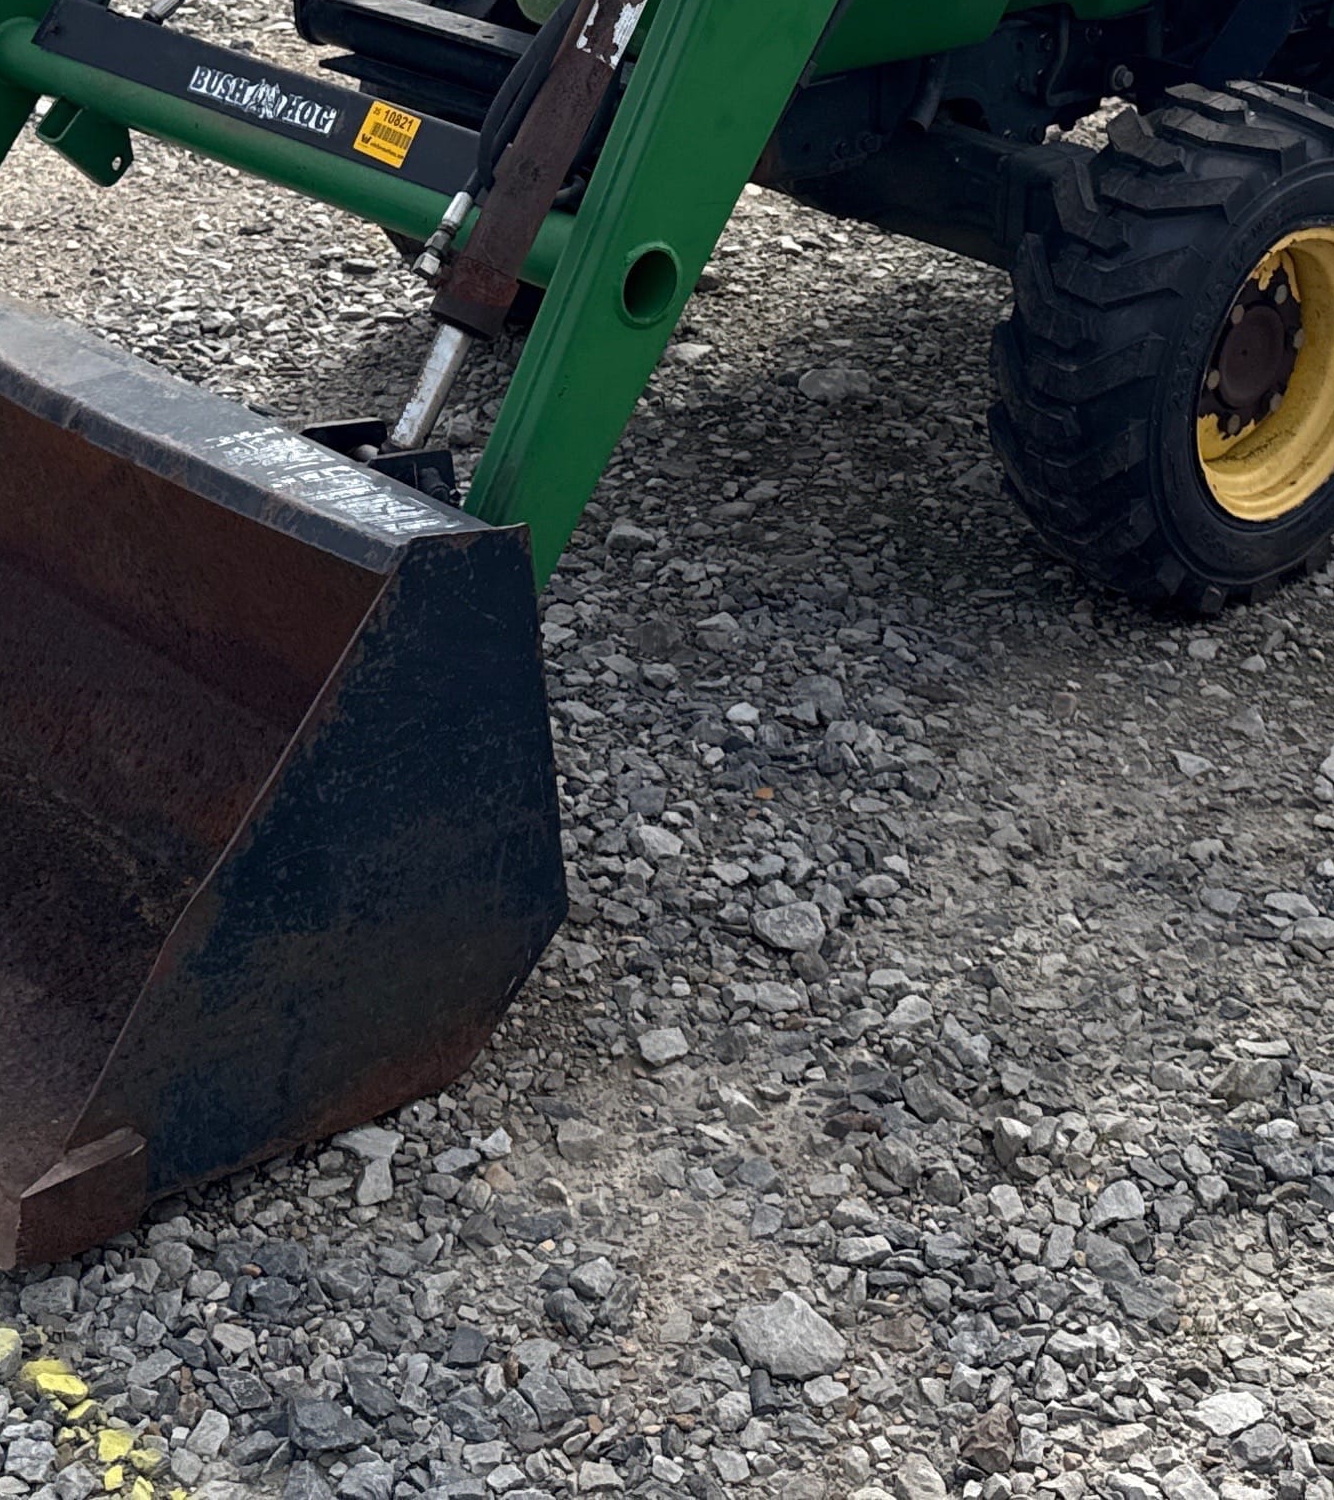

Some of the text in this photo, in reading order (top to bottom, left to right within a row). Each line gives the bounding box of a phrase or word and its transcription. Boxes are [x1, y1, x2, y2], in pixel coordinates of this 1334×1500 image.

[188, 66, 338, 135] BUSH HOG
[383, 109, 415, 133] 10821
